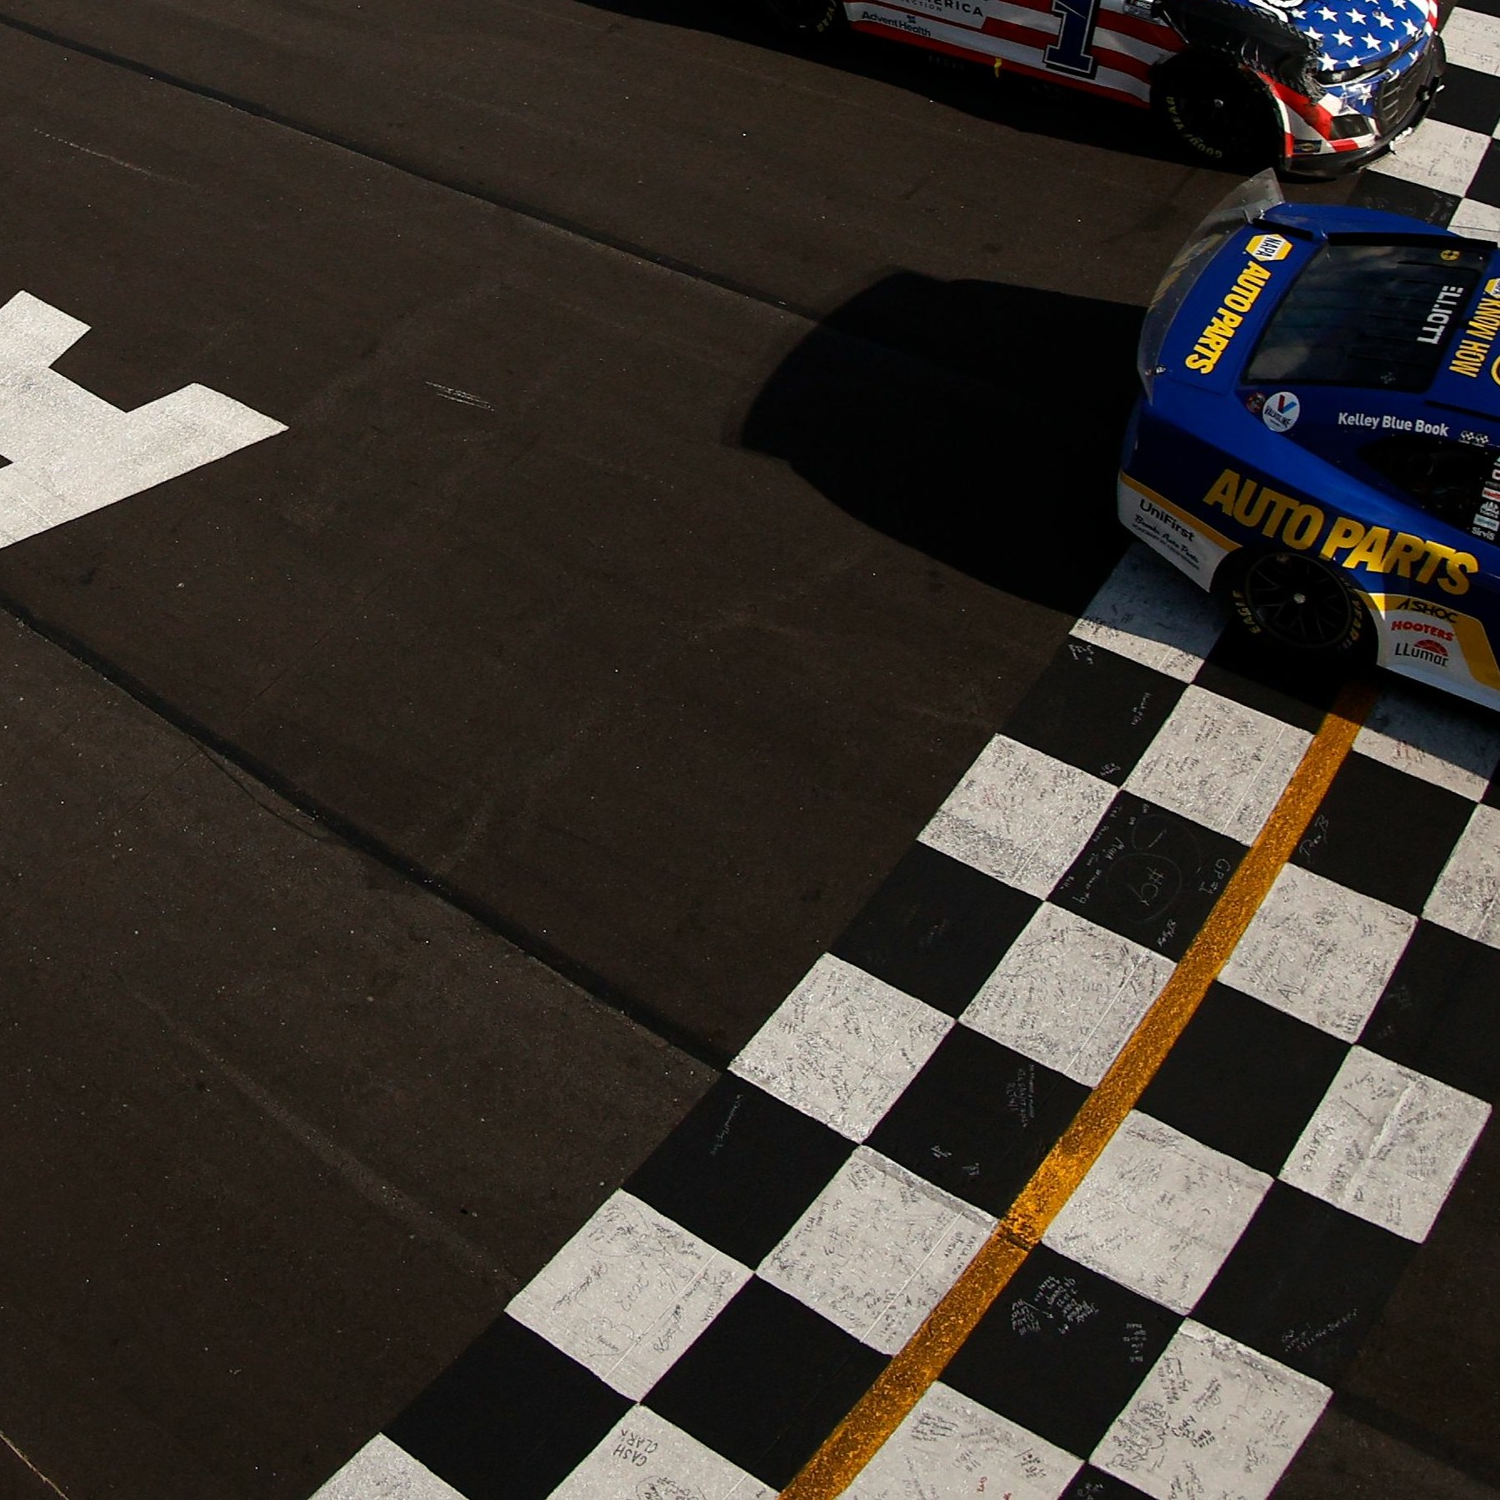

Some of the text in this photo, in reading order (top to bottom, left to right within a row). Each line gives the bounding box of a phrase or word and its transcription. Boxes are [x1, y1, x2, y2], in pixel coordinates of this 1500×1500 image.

[861, 11, 932, 37] AdventHealth
[1255, 237, 1283, 258] NAPA
[1185, 260, 1271, 375] AUTO PARTS
[1449, 339, 1491, 378] HOW
[1338, 412, 1450, 437] Kelley Blue Book
[1139, 498, 1196, 542] UniFirst
[1202, 468, 1325, 551] AUTO
[1318, 516, 1479, 596] PARTS
[1391, 620, 1455, 642] HOOTERS
[1395, 642, 1449, 668] LLumar
[612, 1443, 648, 1467] CASH
